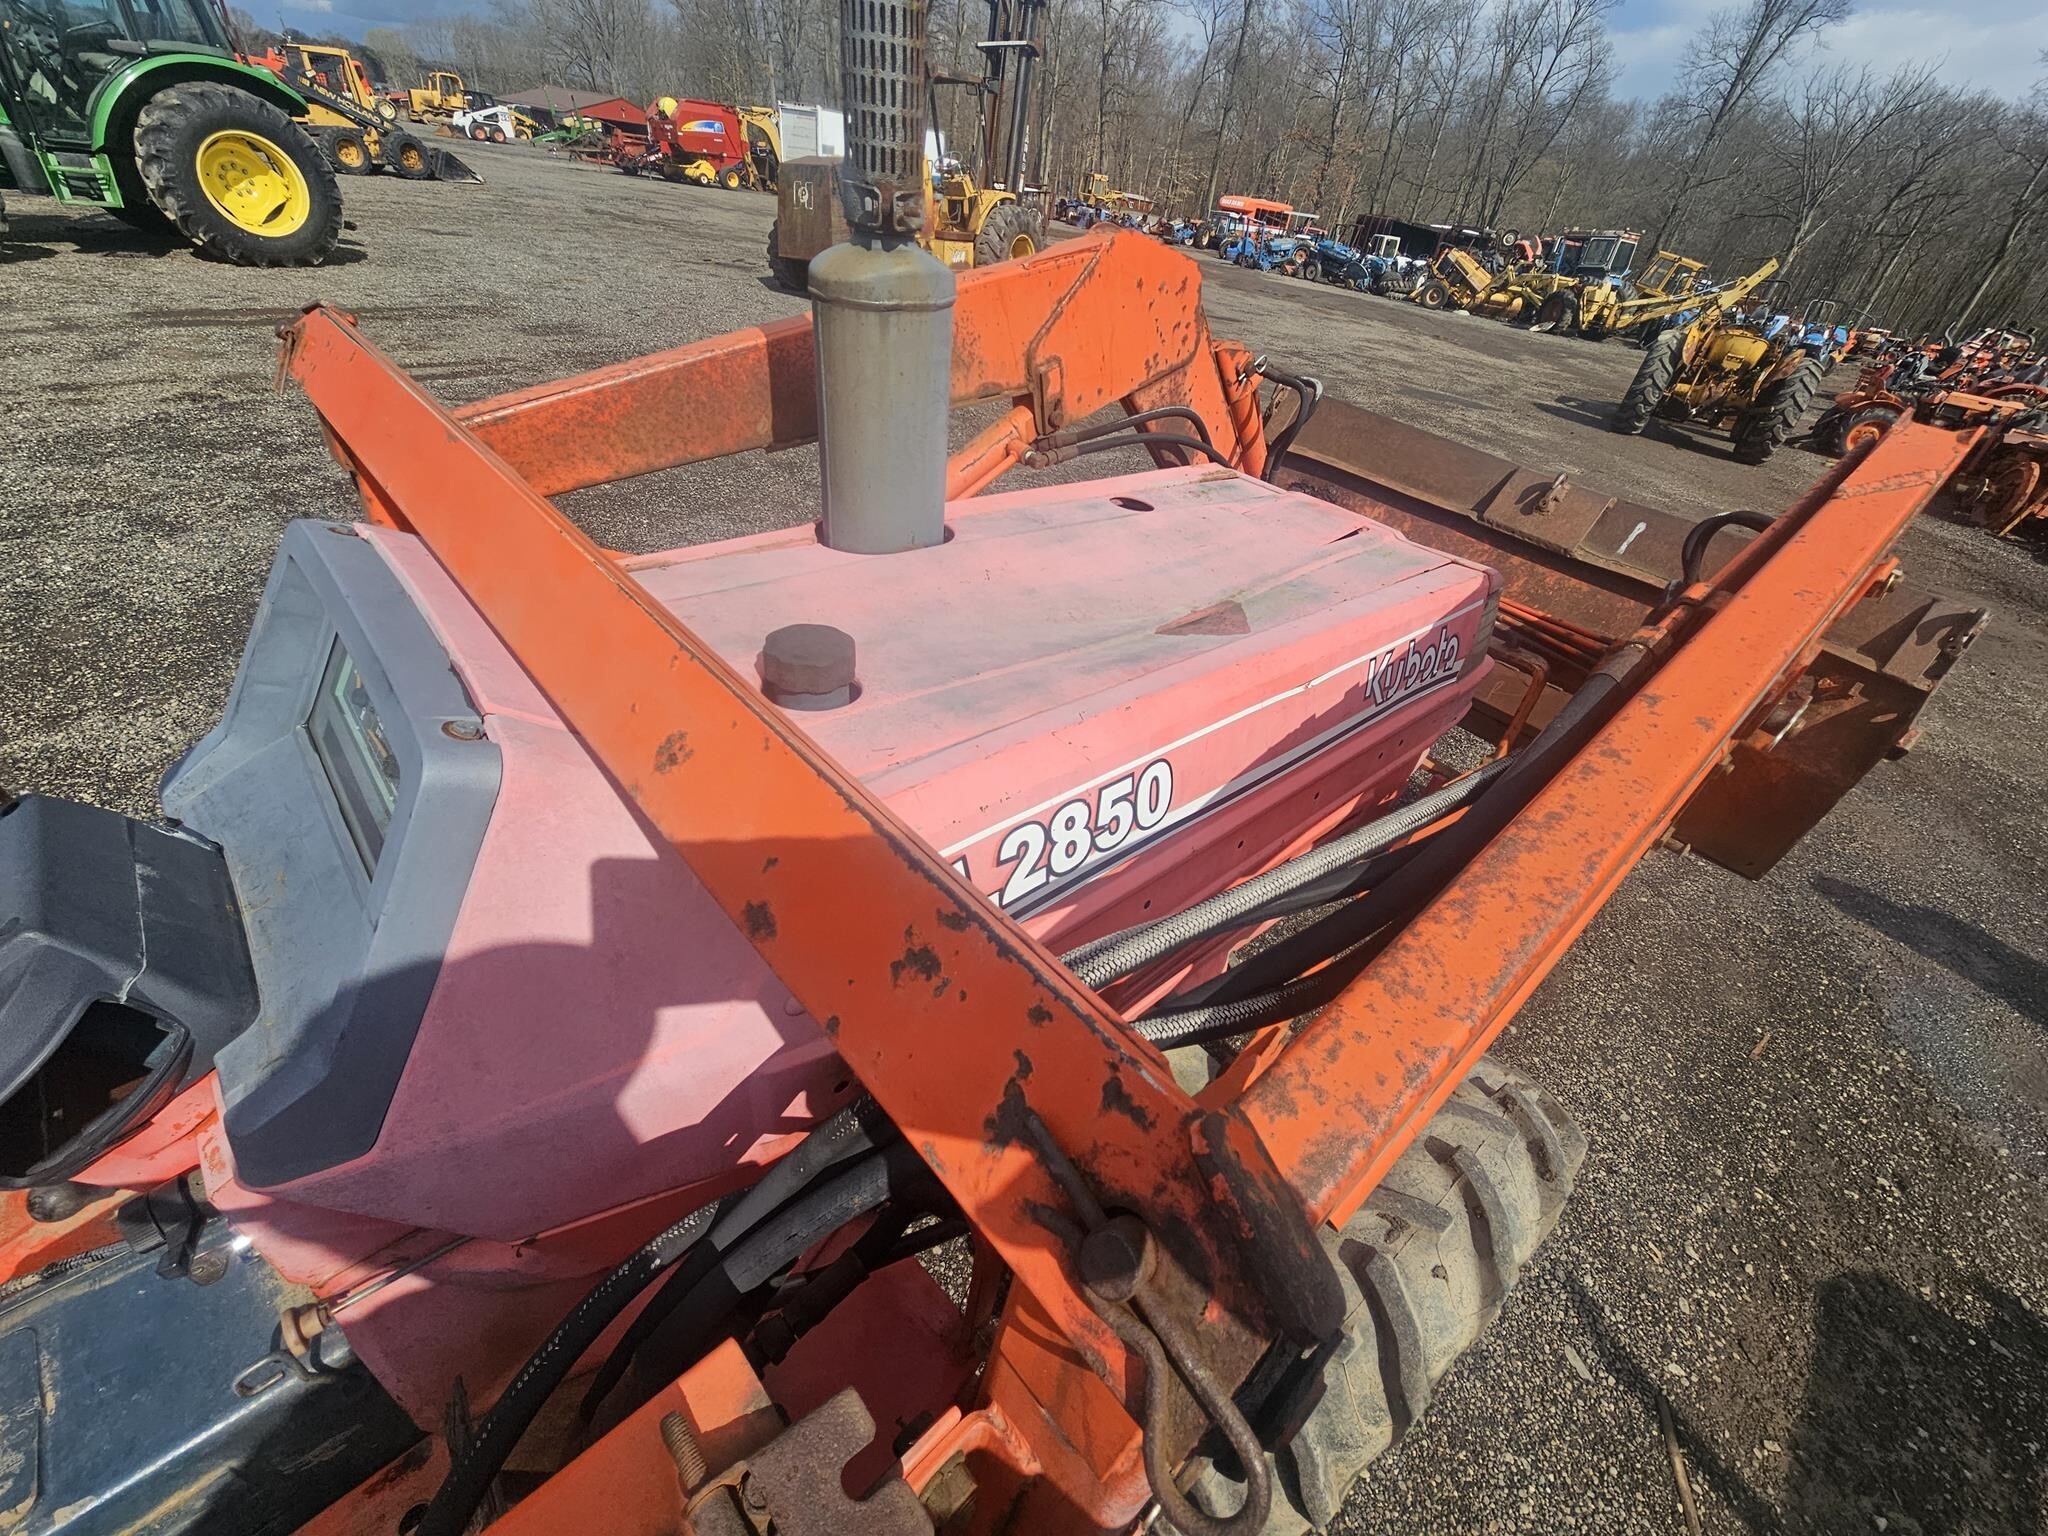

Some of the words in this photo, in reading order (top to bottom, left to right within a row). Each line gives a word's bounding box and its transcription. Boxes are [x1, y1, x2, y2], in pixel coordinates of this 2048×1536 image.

[313, 84, 337, 100] NEW
[336, 96, 381, 124] HOLLAND
[1363, 626, 1460, 706] Kubota
[996, 758, 1173, 910] 2850
